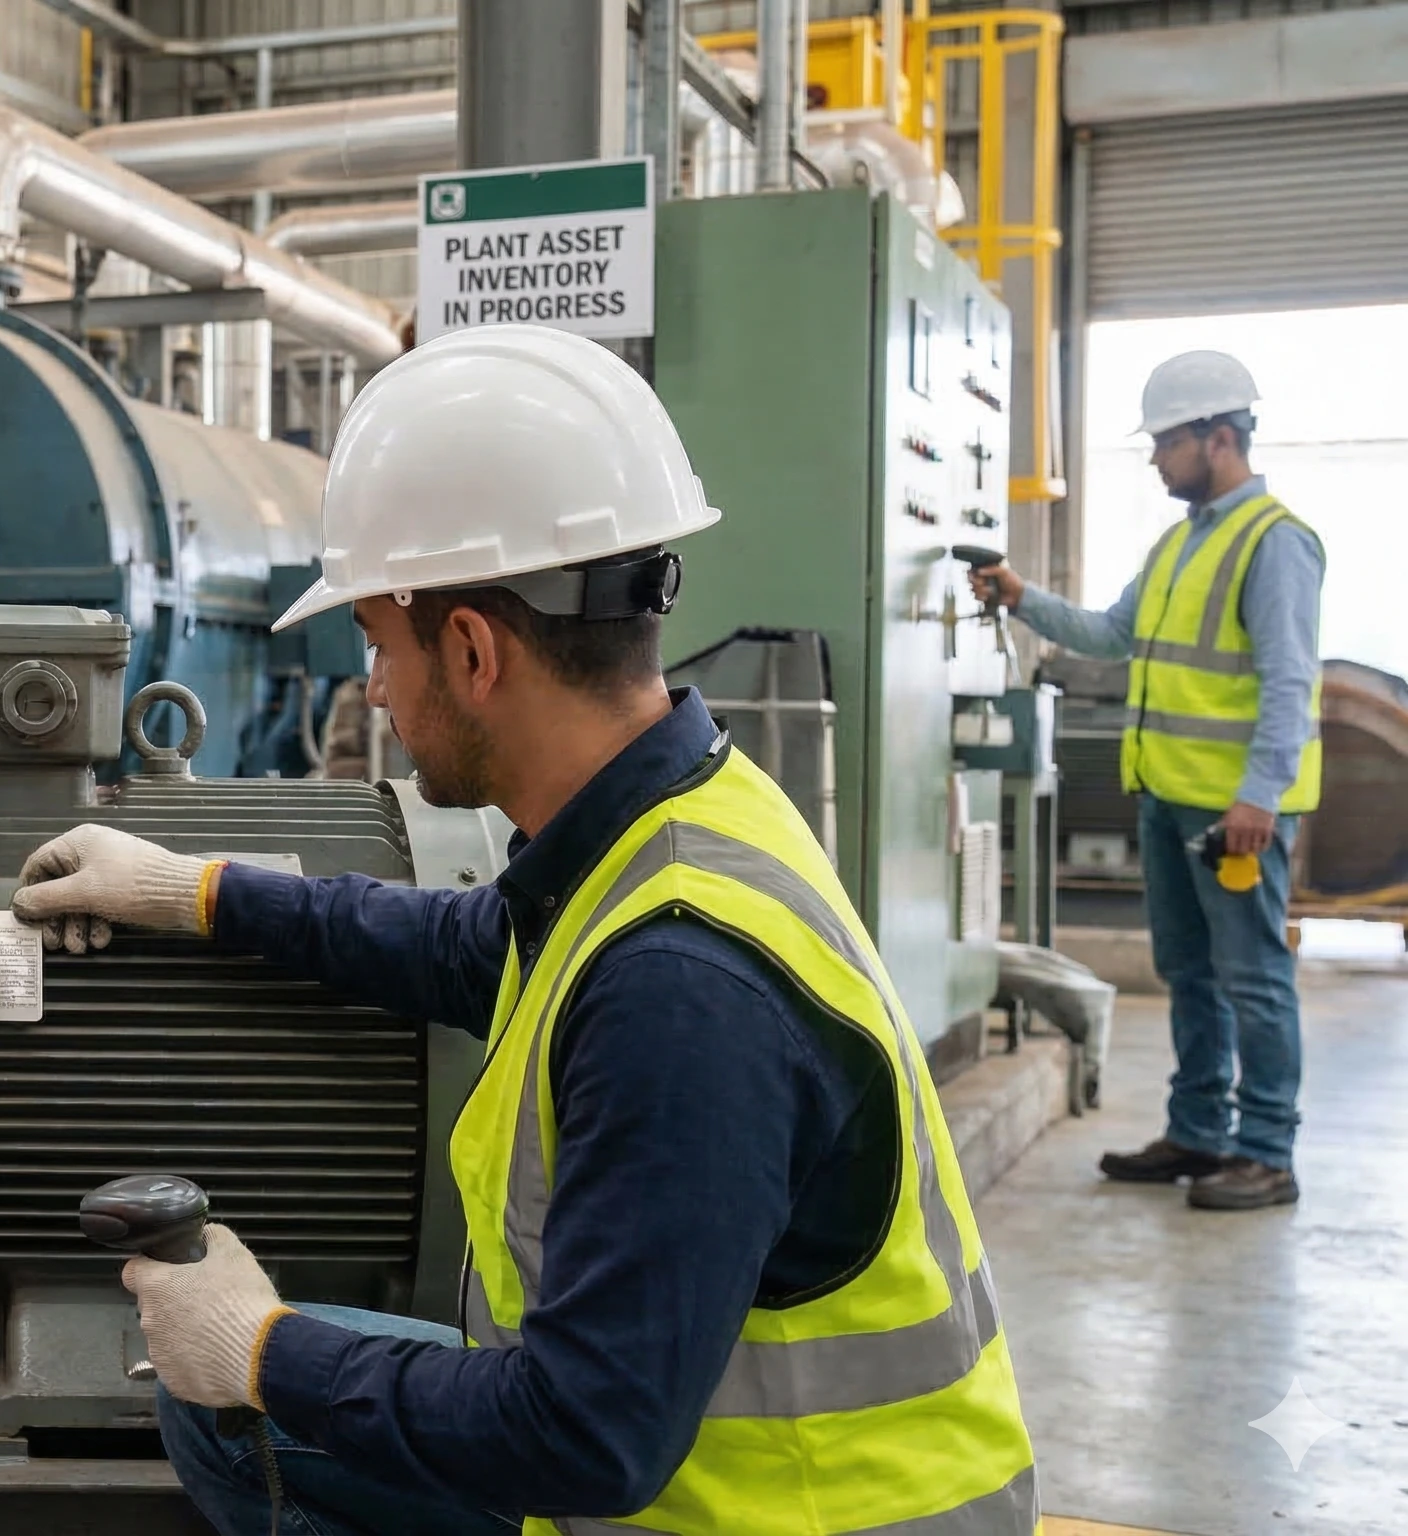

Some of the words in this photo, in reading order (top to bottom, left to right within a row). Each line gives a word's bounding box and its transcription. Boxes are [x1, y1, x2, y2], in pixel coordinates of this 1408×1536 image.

[445, 233, 529, 262] PLANT
[538, 225, 624, 256] ASSET
[458, 259, 610, 293] INVENTORY
[444, 300, 469, 326] IN
[480, 291, 626, 323] PROGRESS
